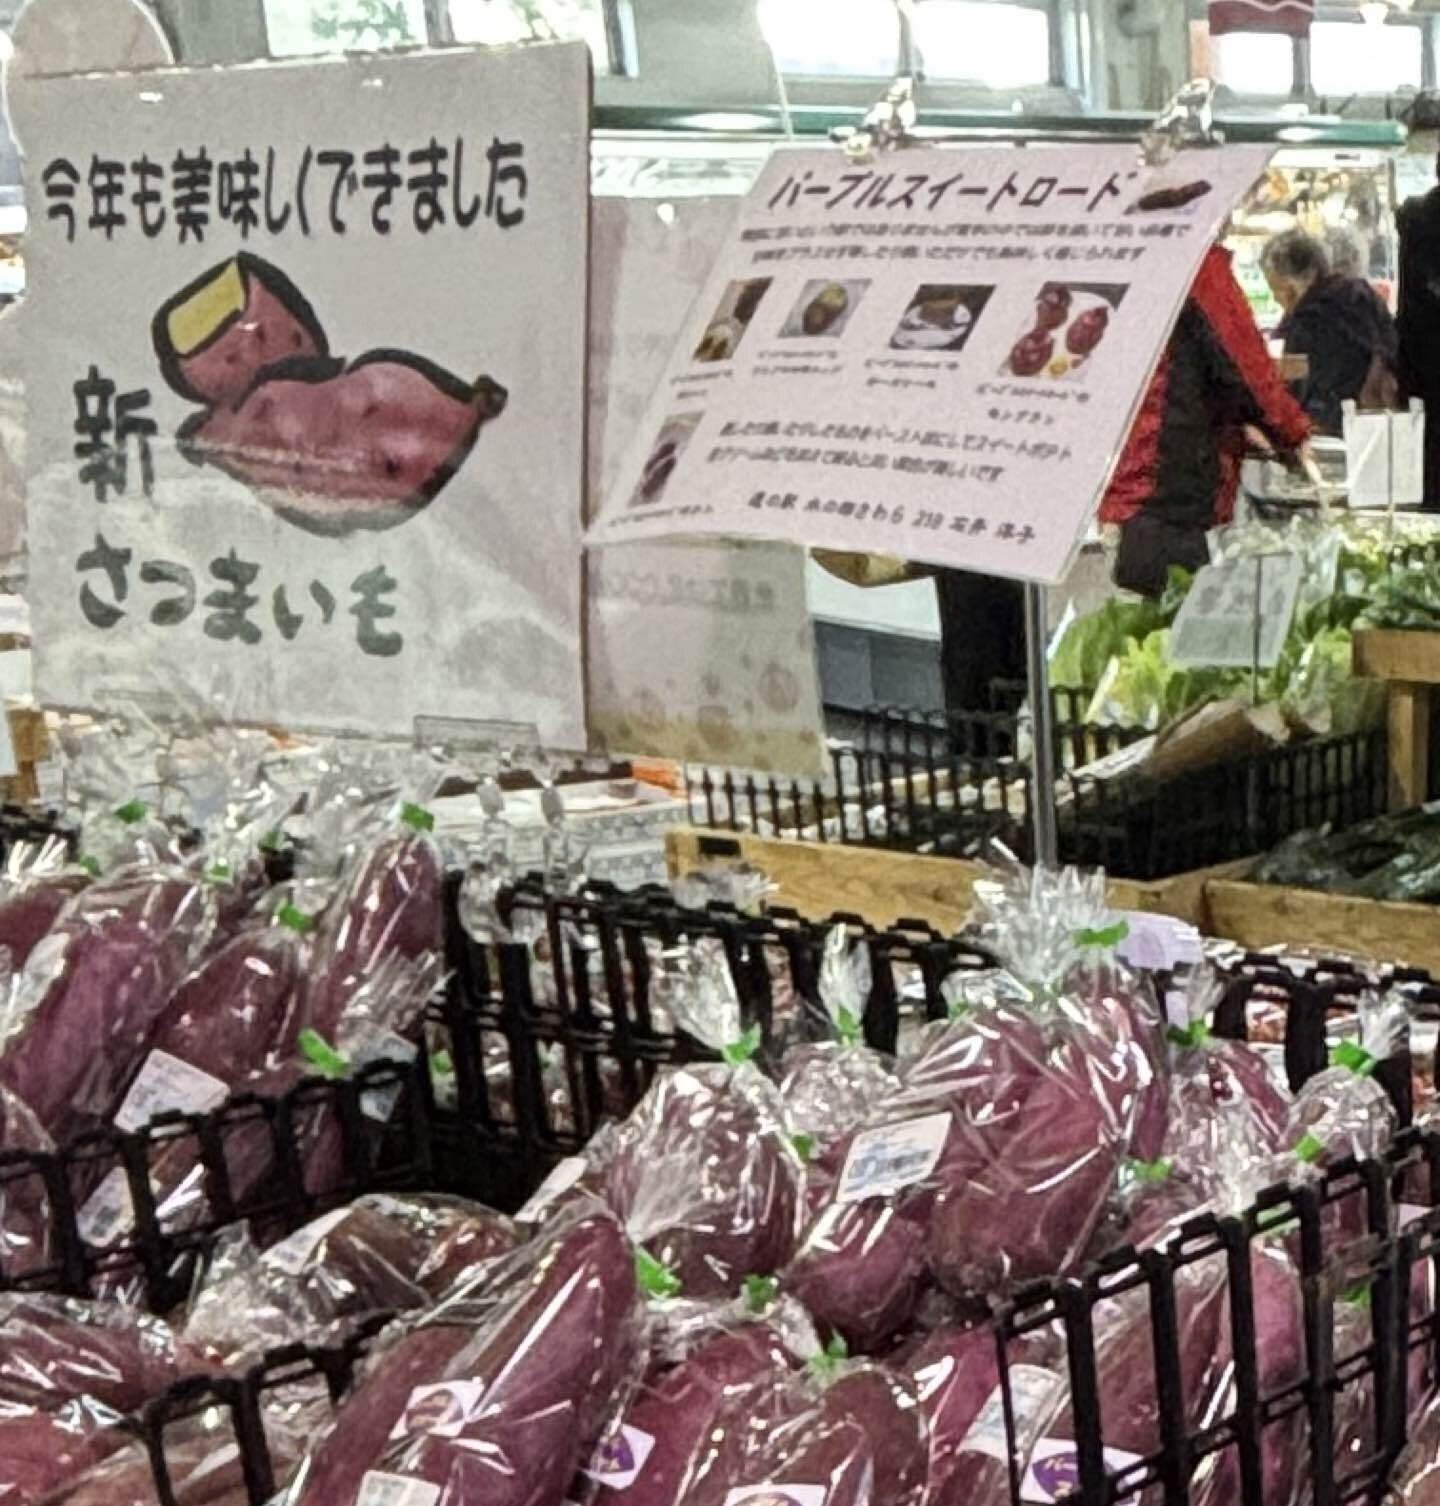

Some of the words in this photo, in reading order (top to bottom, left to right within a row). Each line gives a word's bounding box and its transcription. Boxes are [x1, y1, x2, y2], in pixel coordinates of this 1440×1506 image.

[41, 137, 528, 243] 今年も美味しくできました
[767, 168, 1139, 215] パープルスイートロード
[72, 365, 159, 503] 新
[75, 534, 405, 657] さつまいも
